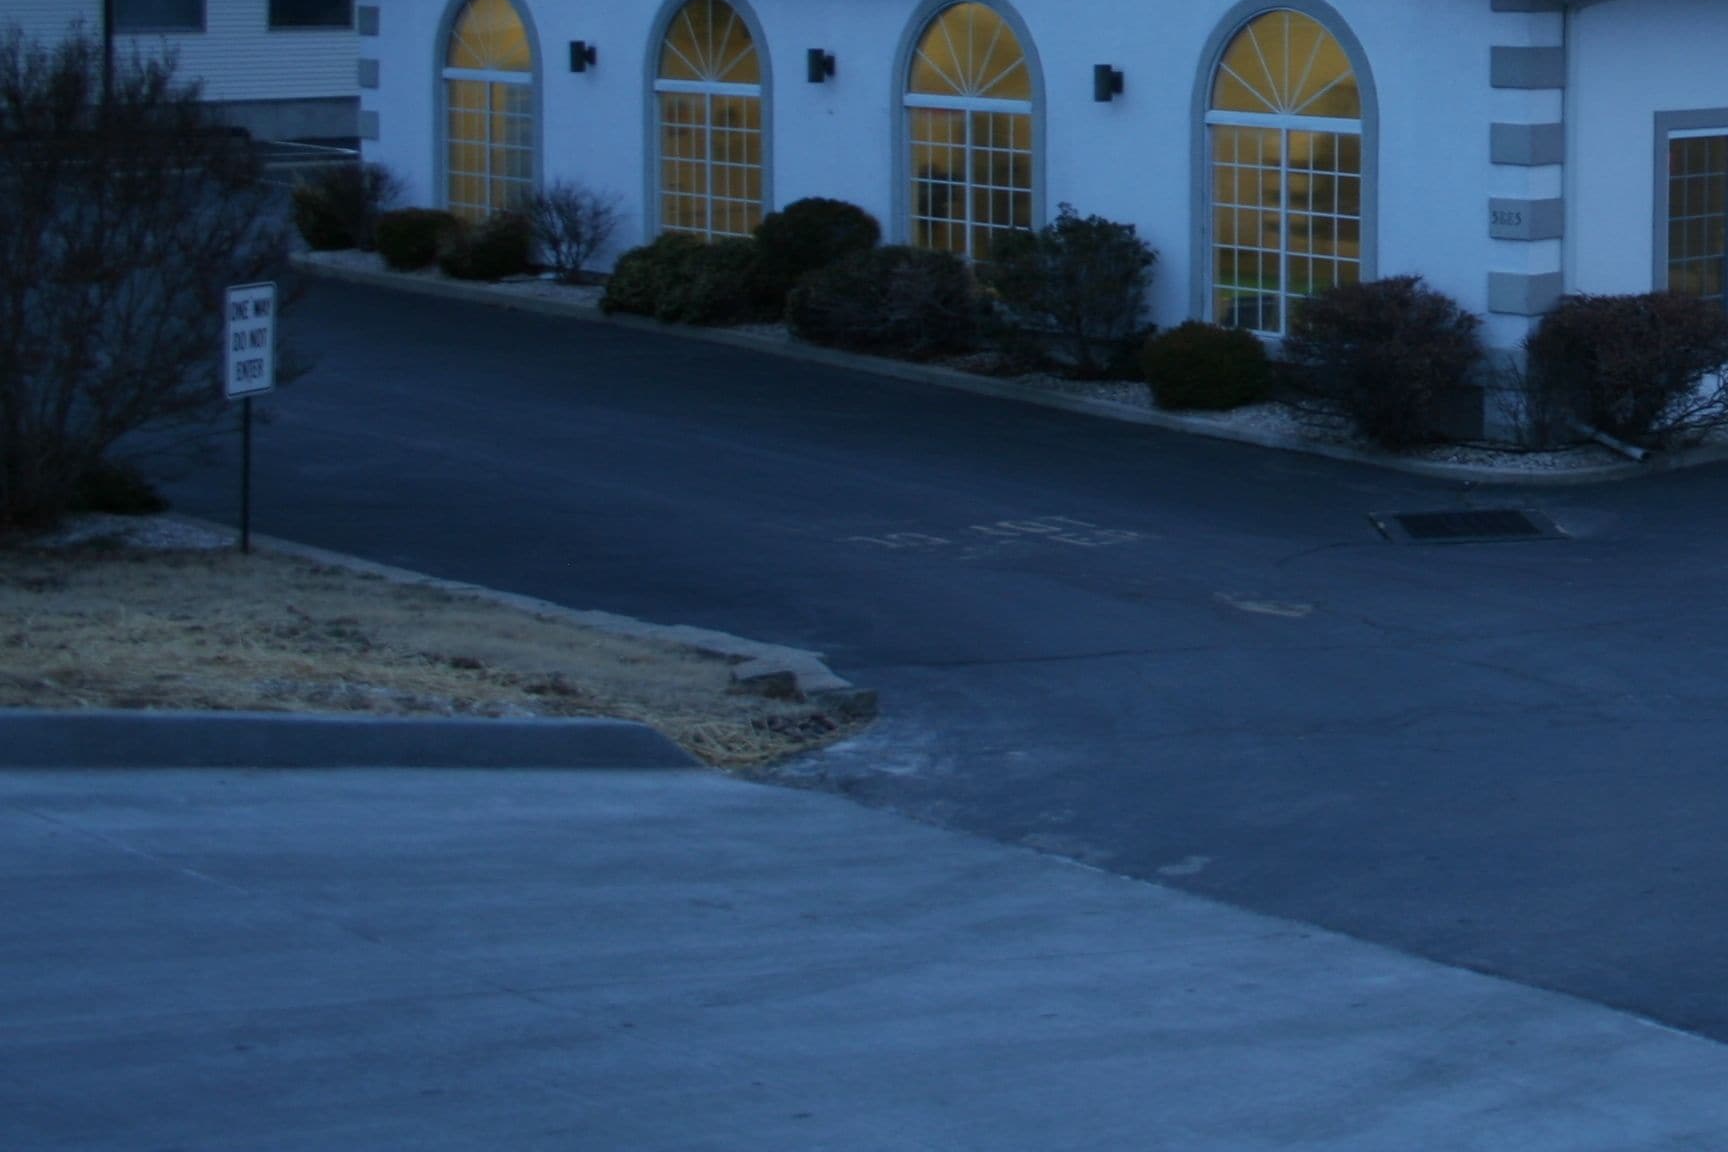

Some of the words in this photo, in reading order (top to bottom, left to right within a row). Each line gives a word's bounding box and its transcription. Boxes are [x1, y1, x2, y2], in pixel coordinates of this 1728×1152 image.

[232, 331, 248, 352] DO
[249, 328, 267, 348] NOT
[236, 358, 264, 382] ENTER
